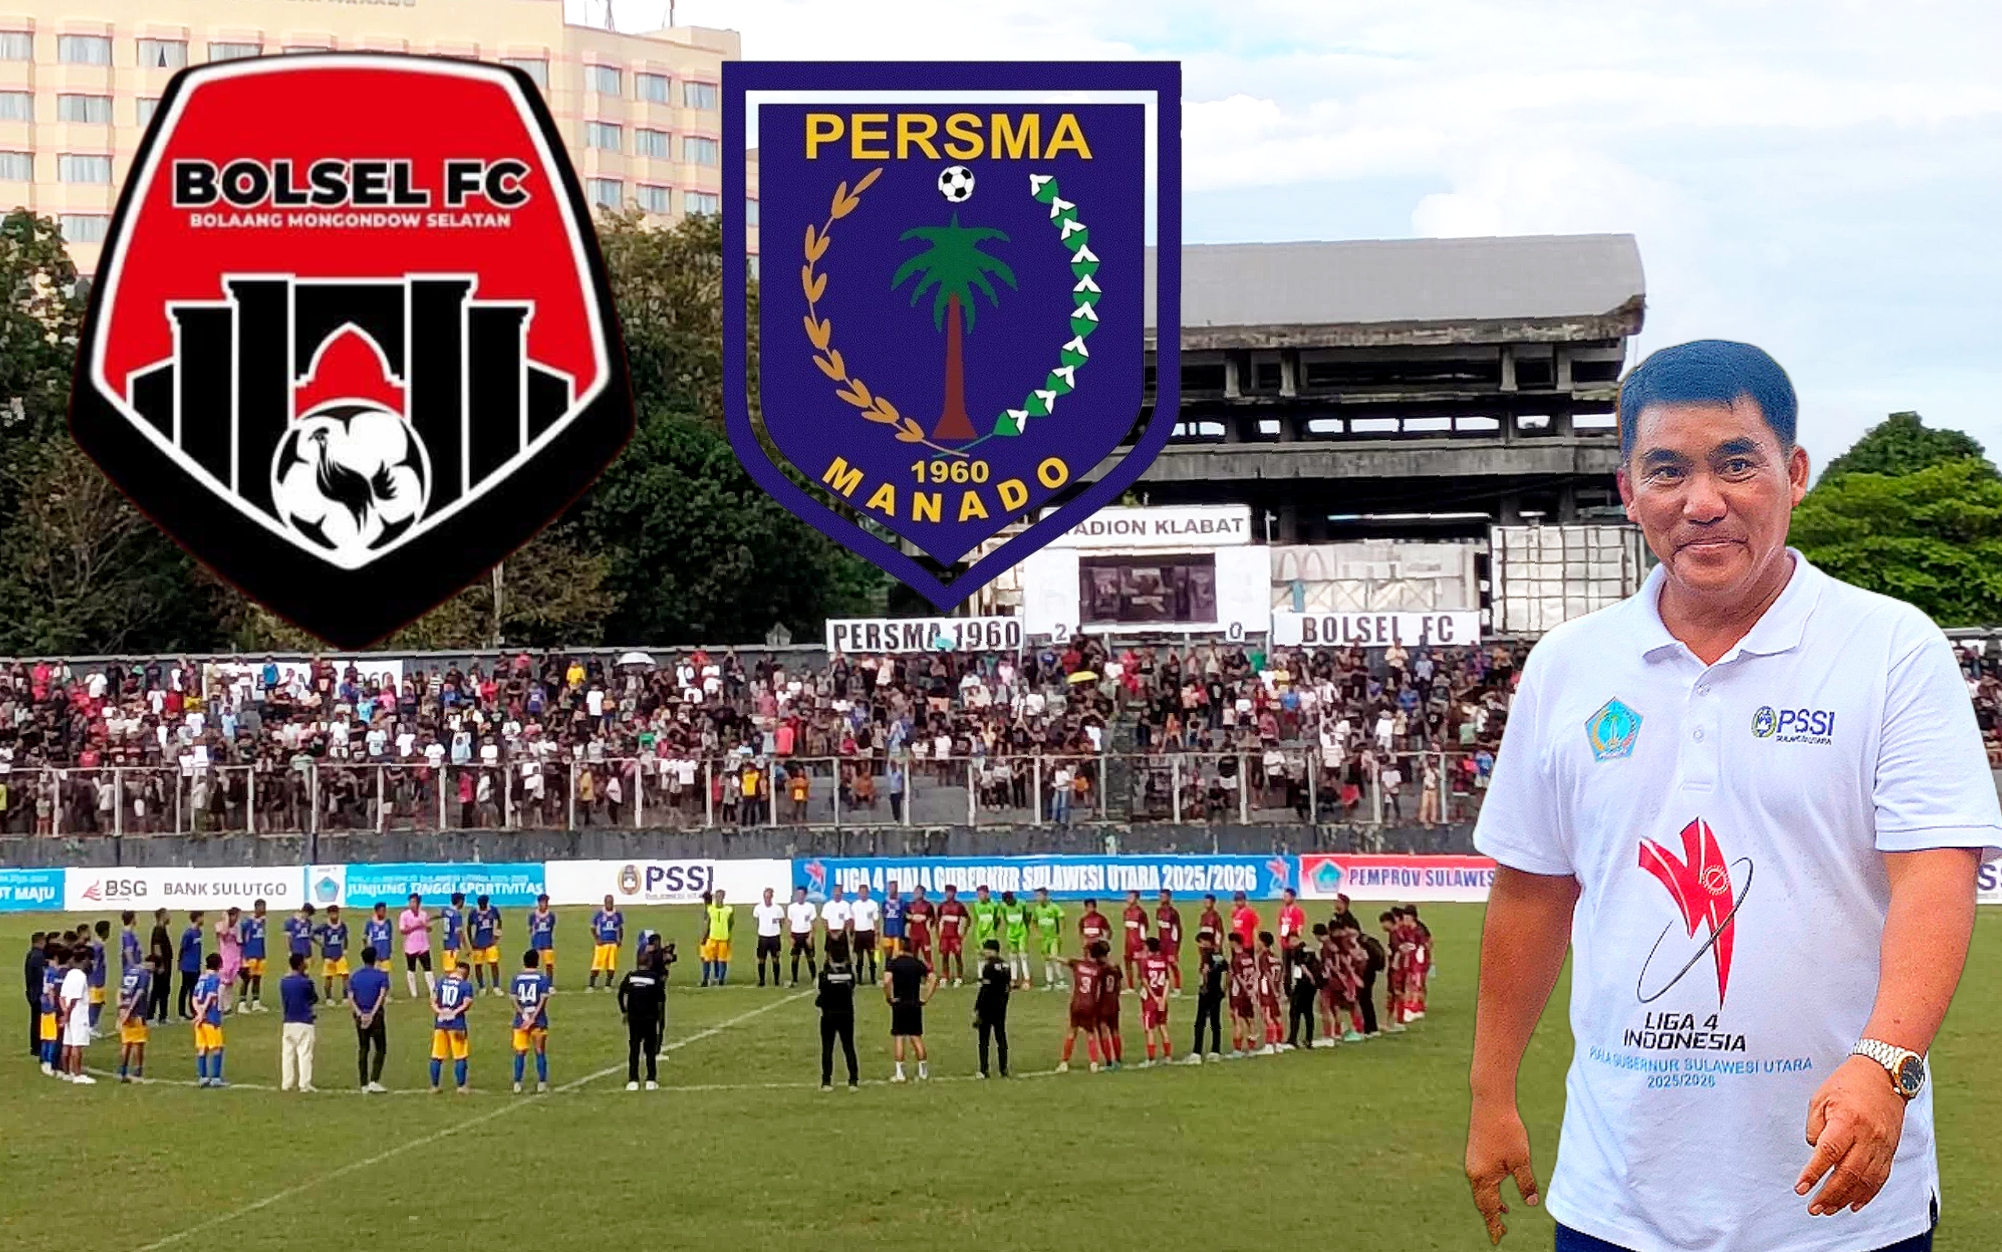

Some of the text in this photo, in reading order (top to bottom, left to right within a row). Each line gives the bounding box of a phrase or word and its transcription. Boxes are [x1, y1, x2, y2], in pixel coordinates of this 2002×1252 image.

[1064, 517, 1245, 536] ADION KLABAT
[832, 620, 1021, 651] PERSMA 1960
[1055, 622, 1068, 641] 2
[1302, 614, 1455, 643] BOLSEL FC
[1776, 708, 1835, 736] PSSI
[646, 865, 714, 892] PSSI
[873, 867, 885, 893] 4
[933, 865, 1020, 894] GUBERNUR
[1022, 864, 1105, 892] SULAWESI
[1107, 864, 1161, 892] UTARA
[1162, 864, 1258, 892] 2025/2026
[1349, 868, 1421, 887] PEMPROV
[15, 886, 56, 904] MAJU
[105, 879, 288, 897] BSG BANK SULUTGO
[347, 882, 407, 898] JUNJUNG
[459, 881, 544, 896] SPORTIVITAS
[1148, 970, 1166, 988] 24
[441, 984, 460, 1007] 10
[1644, 1012, 1719, 1031] LIGA 4
[1623, 1029, 1747, 1052] INDONESIA
[1613, 1053, 1681, 1073] GUBERNUR
[1684, 1058, 1760, 1075] SULAWESI
[1763, 1056, 1814, 1074] UTARA
[1647, 1073, 1717, 1089] 2025/2026
